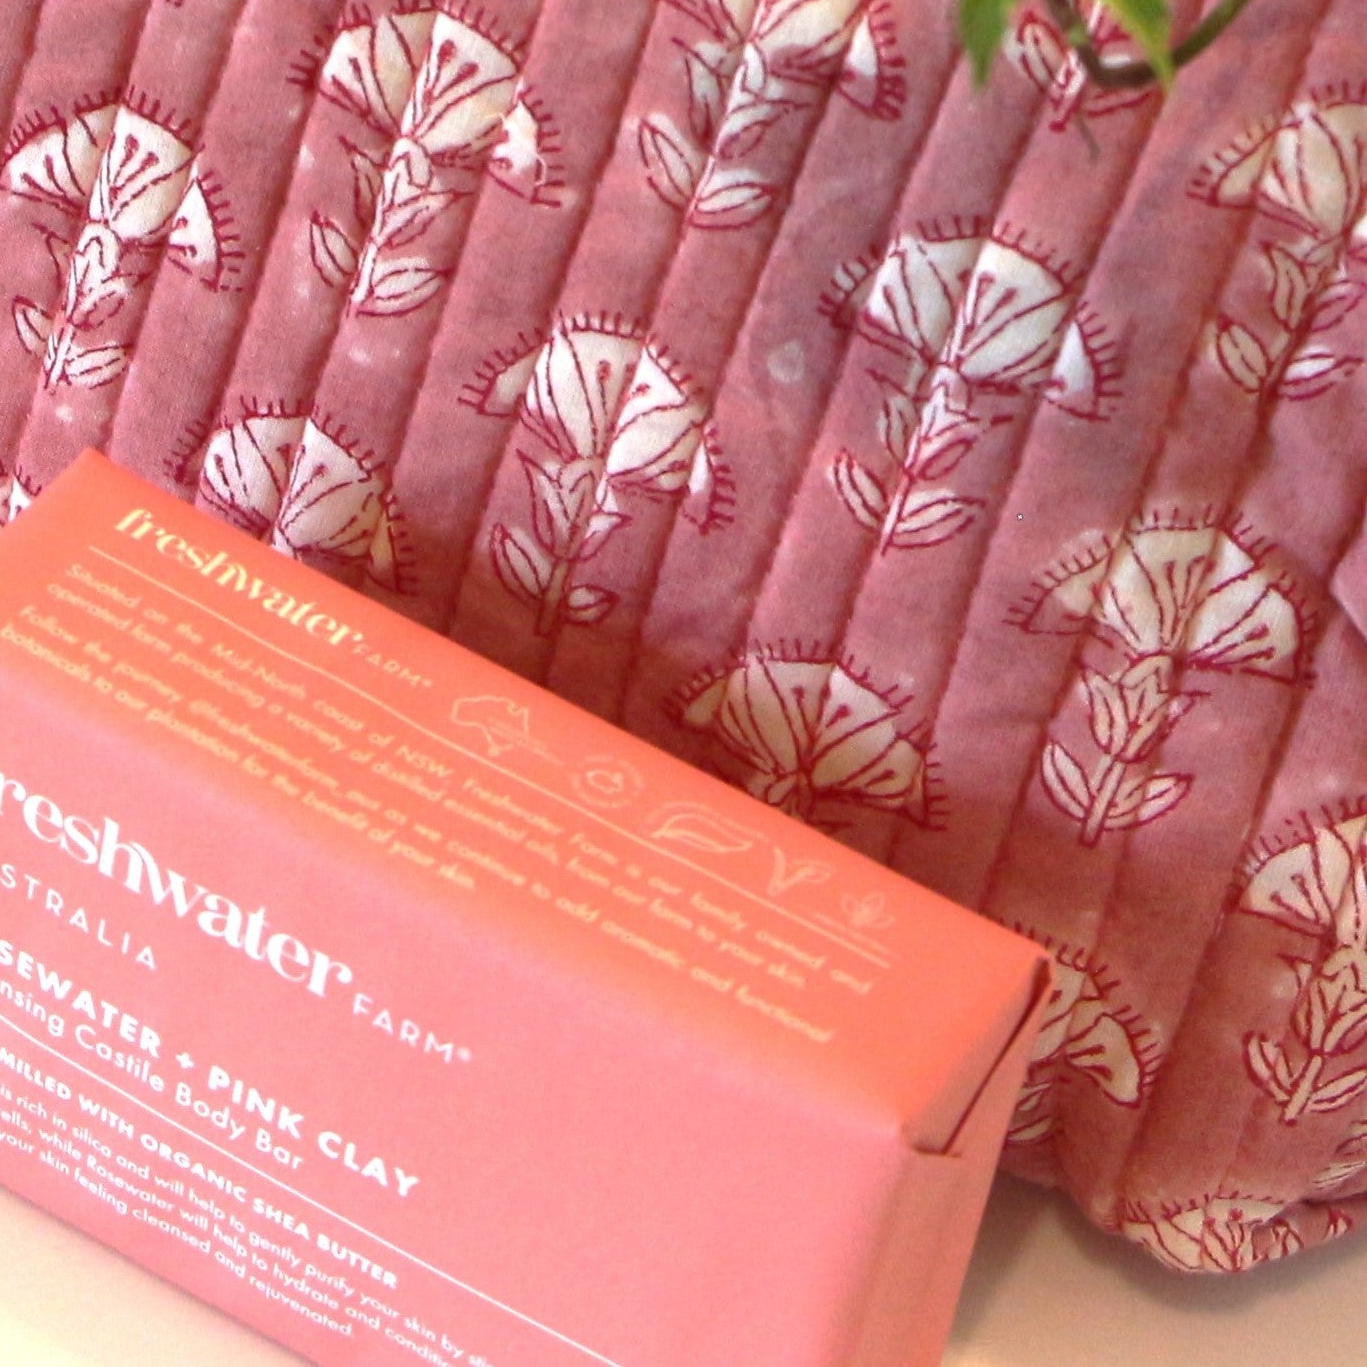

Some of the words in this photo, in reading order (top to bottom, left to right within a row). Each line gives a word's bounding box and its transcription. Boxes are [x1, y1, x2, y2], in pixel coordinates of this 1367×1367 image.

[115, 507, 364, 648] freshwater
[75, 1023, 165, 1093] Castile
[175, 1082, 246, 1141] Body
[255, 1127, 305, 1171] Bar
[208, 1064, 305, 1140] PINK
[317, 1131, 421, 1199] CLAY
[0, 1084, 13, 1101] is
[17, 1095, 48, 1120] rich
[52, 1113, 67, 1131] in
[71, 1125, 113, 1159] silica
[115, 1152, 151, 1180] and
[154, 1174, 184, 1197] will
[187, 1187, 226, 1223] help
[229, 1214, 247, 1235] to
[248, 1230, 302, 1269] gently
[304, 1262, 355, 1299] purify
[359, 1292, 401, 1319] your
[404, 1316, 437, 1343] skin
[440, 1333, 465, 1360] by
[38, 1128, 83, 1161] while
[86, 1152, 175, 1212] Rosewater
[179, 1206, 209, 1232] will
[213, 1223, 248, 1259] help
[251, 1252, 269, 1273] to
[273, 1262, 340, 1311] hydrate
[344, 1305, 382, 1331] and
[39, 1149, 71, 1177] skin
[73, 1166, 128, 1216] feeling
[131, 1205, 212, 1257] cleansed
[214, 1248, 247, 1280] and
[77, 1093, 135, 1140] WITH
[139, 1132, 247, 1204] ORGANIC
[252, 1197, 311, 1242] SHEA
[316, 1232, 400, 1290] BUTTER
